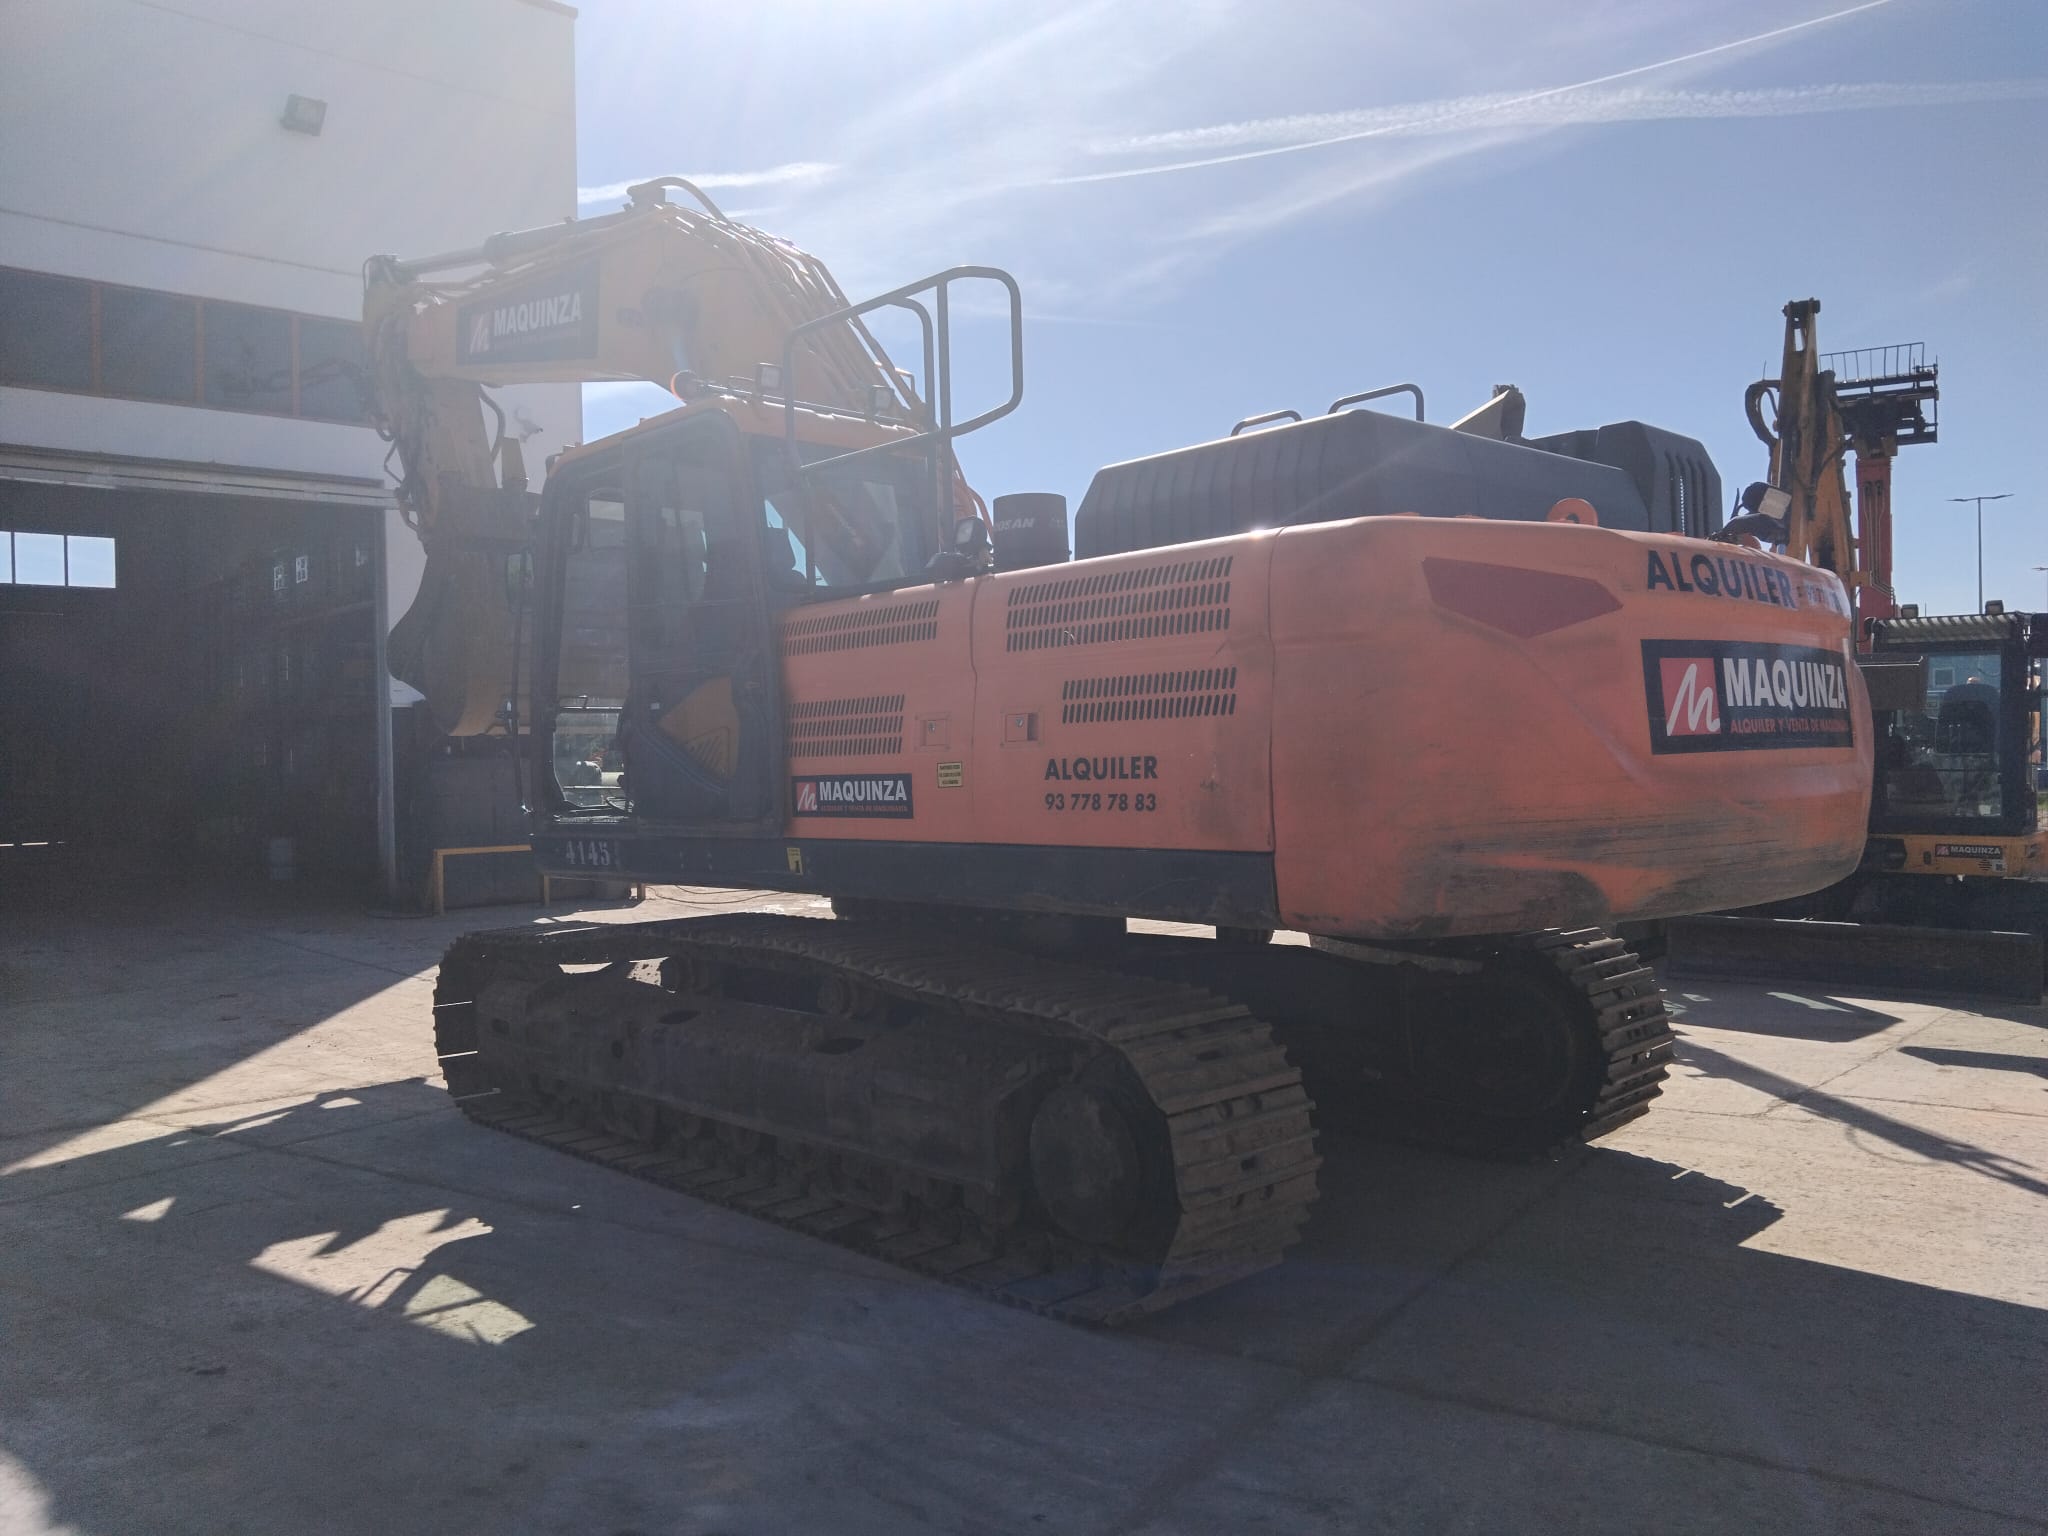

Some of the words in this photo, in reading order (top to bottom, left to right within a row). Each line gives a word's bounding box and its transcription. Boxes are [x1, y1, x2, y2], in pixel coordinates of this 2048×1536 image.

[494, 291, 581, 337] MAQUINZA
[1647, 550, 1797, 609] ALQUILER
[1723, 657, 1847, 711] MAQUINZA
[1730, 718, 1776, 735] ALQUILER
[1044, 756, 1159, 781] ALQUILER
[819, 780, 907, 802] MAQUINZA
[1044, 793, 1065, 811] 93
[1071, 793, 1102, 811] 778
[1107, 793, 1128, 811] 78
[1135, 793, 1157, 811] 83
[565, 840, 610, 866] 4145
[1950, 845, 2001, 855] MAQUINZA
